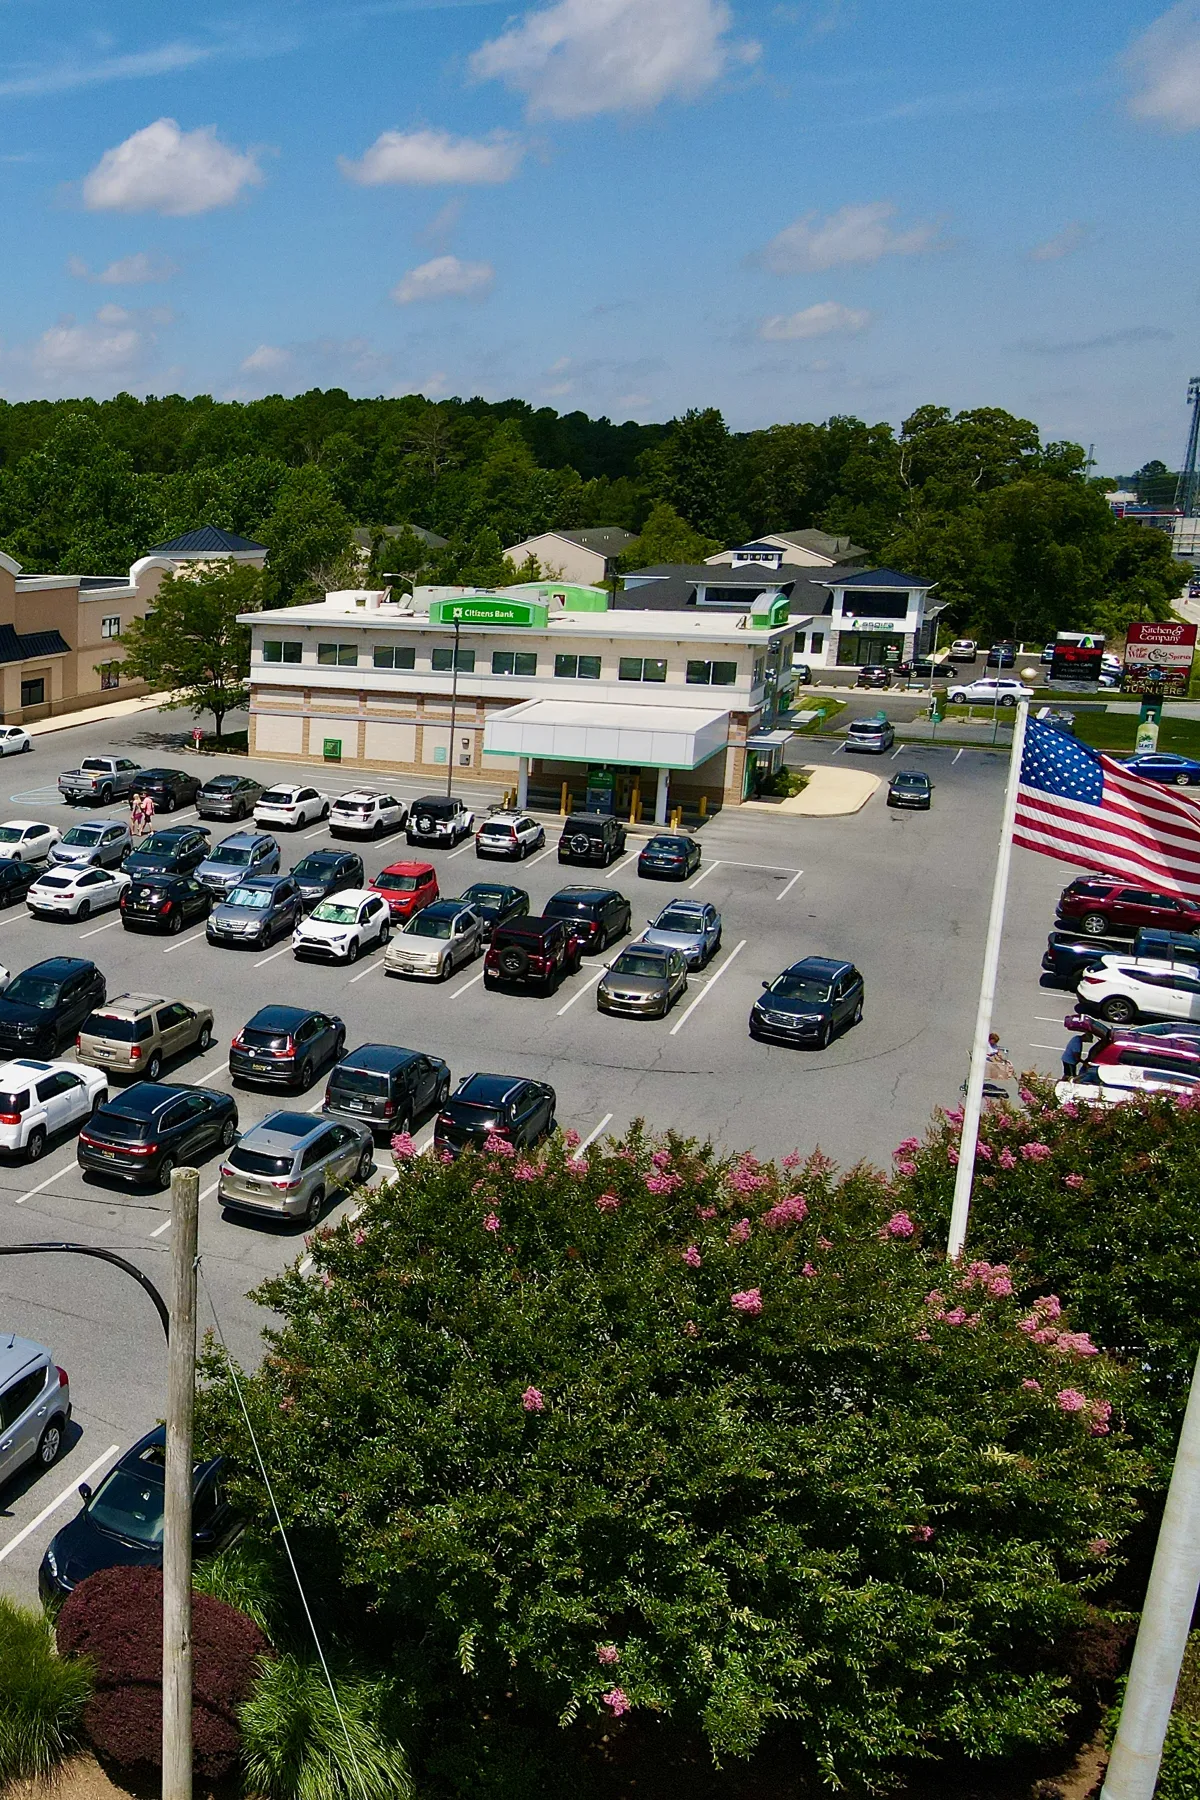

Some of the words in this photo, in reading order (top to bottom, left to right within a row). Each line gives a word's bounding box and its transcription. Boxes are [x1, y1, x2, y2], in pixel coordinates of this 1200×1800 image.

[464, 609, 494, 617] Citizens
[494, 610, 514, 618] Bank
[1141, 625, 1172, 634] Kitchen
[1139, 633, 1181, 643] Company
